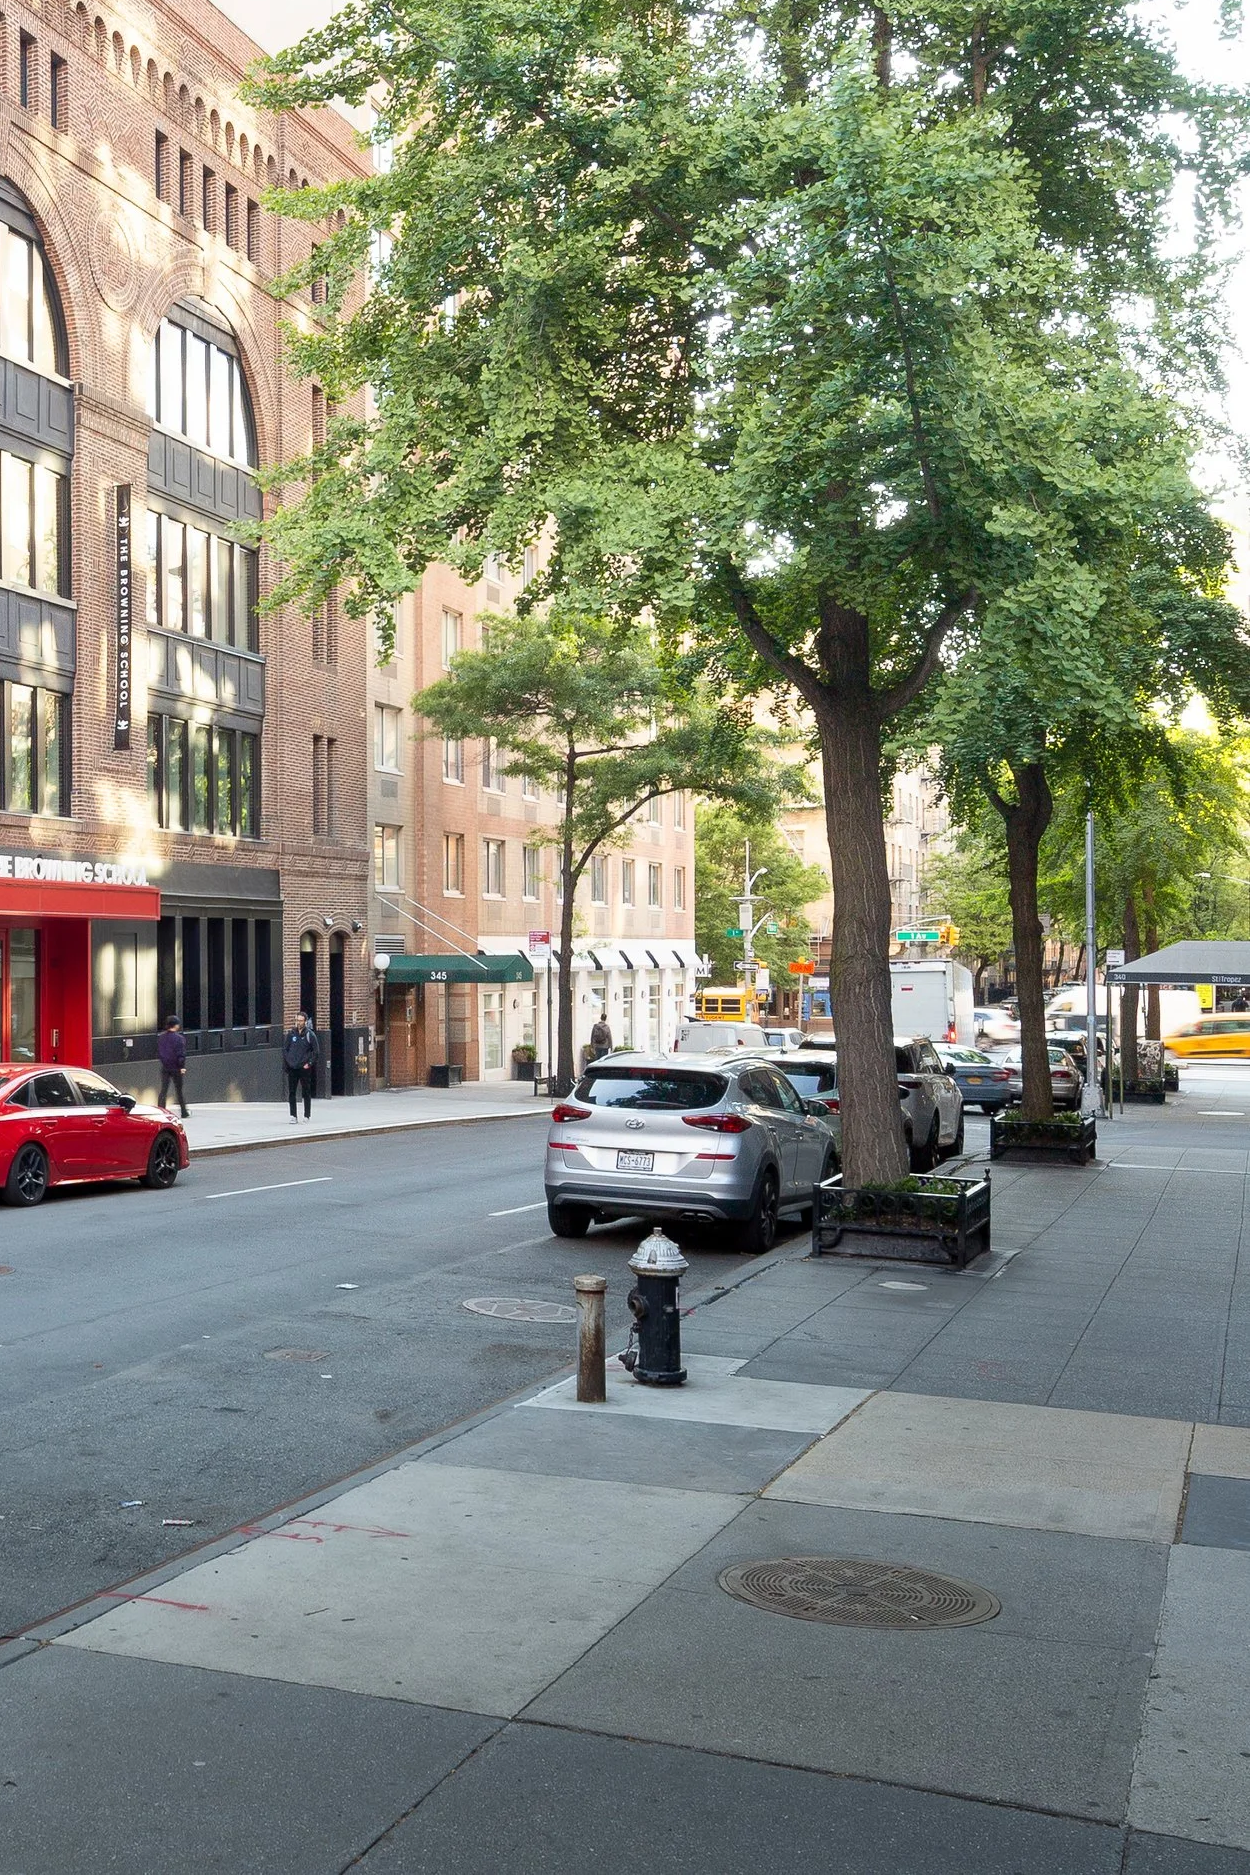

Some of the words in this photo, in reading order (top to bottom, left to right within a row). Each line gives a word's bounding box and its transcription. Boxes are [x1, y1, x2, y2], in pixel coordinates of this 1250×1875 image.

[119, 538, 129, 563] THE
[120, 569, 129, 645] BROWNING
[119, 651, 129, 708] SCHOOL
[14, 856, 93, 883] BROWNING
[94, 862, 149, 886] SCHOOL
[430, 971, 447, 981] 345
